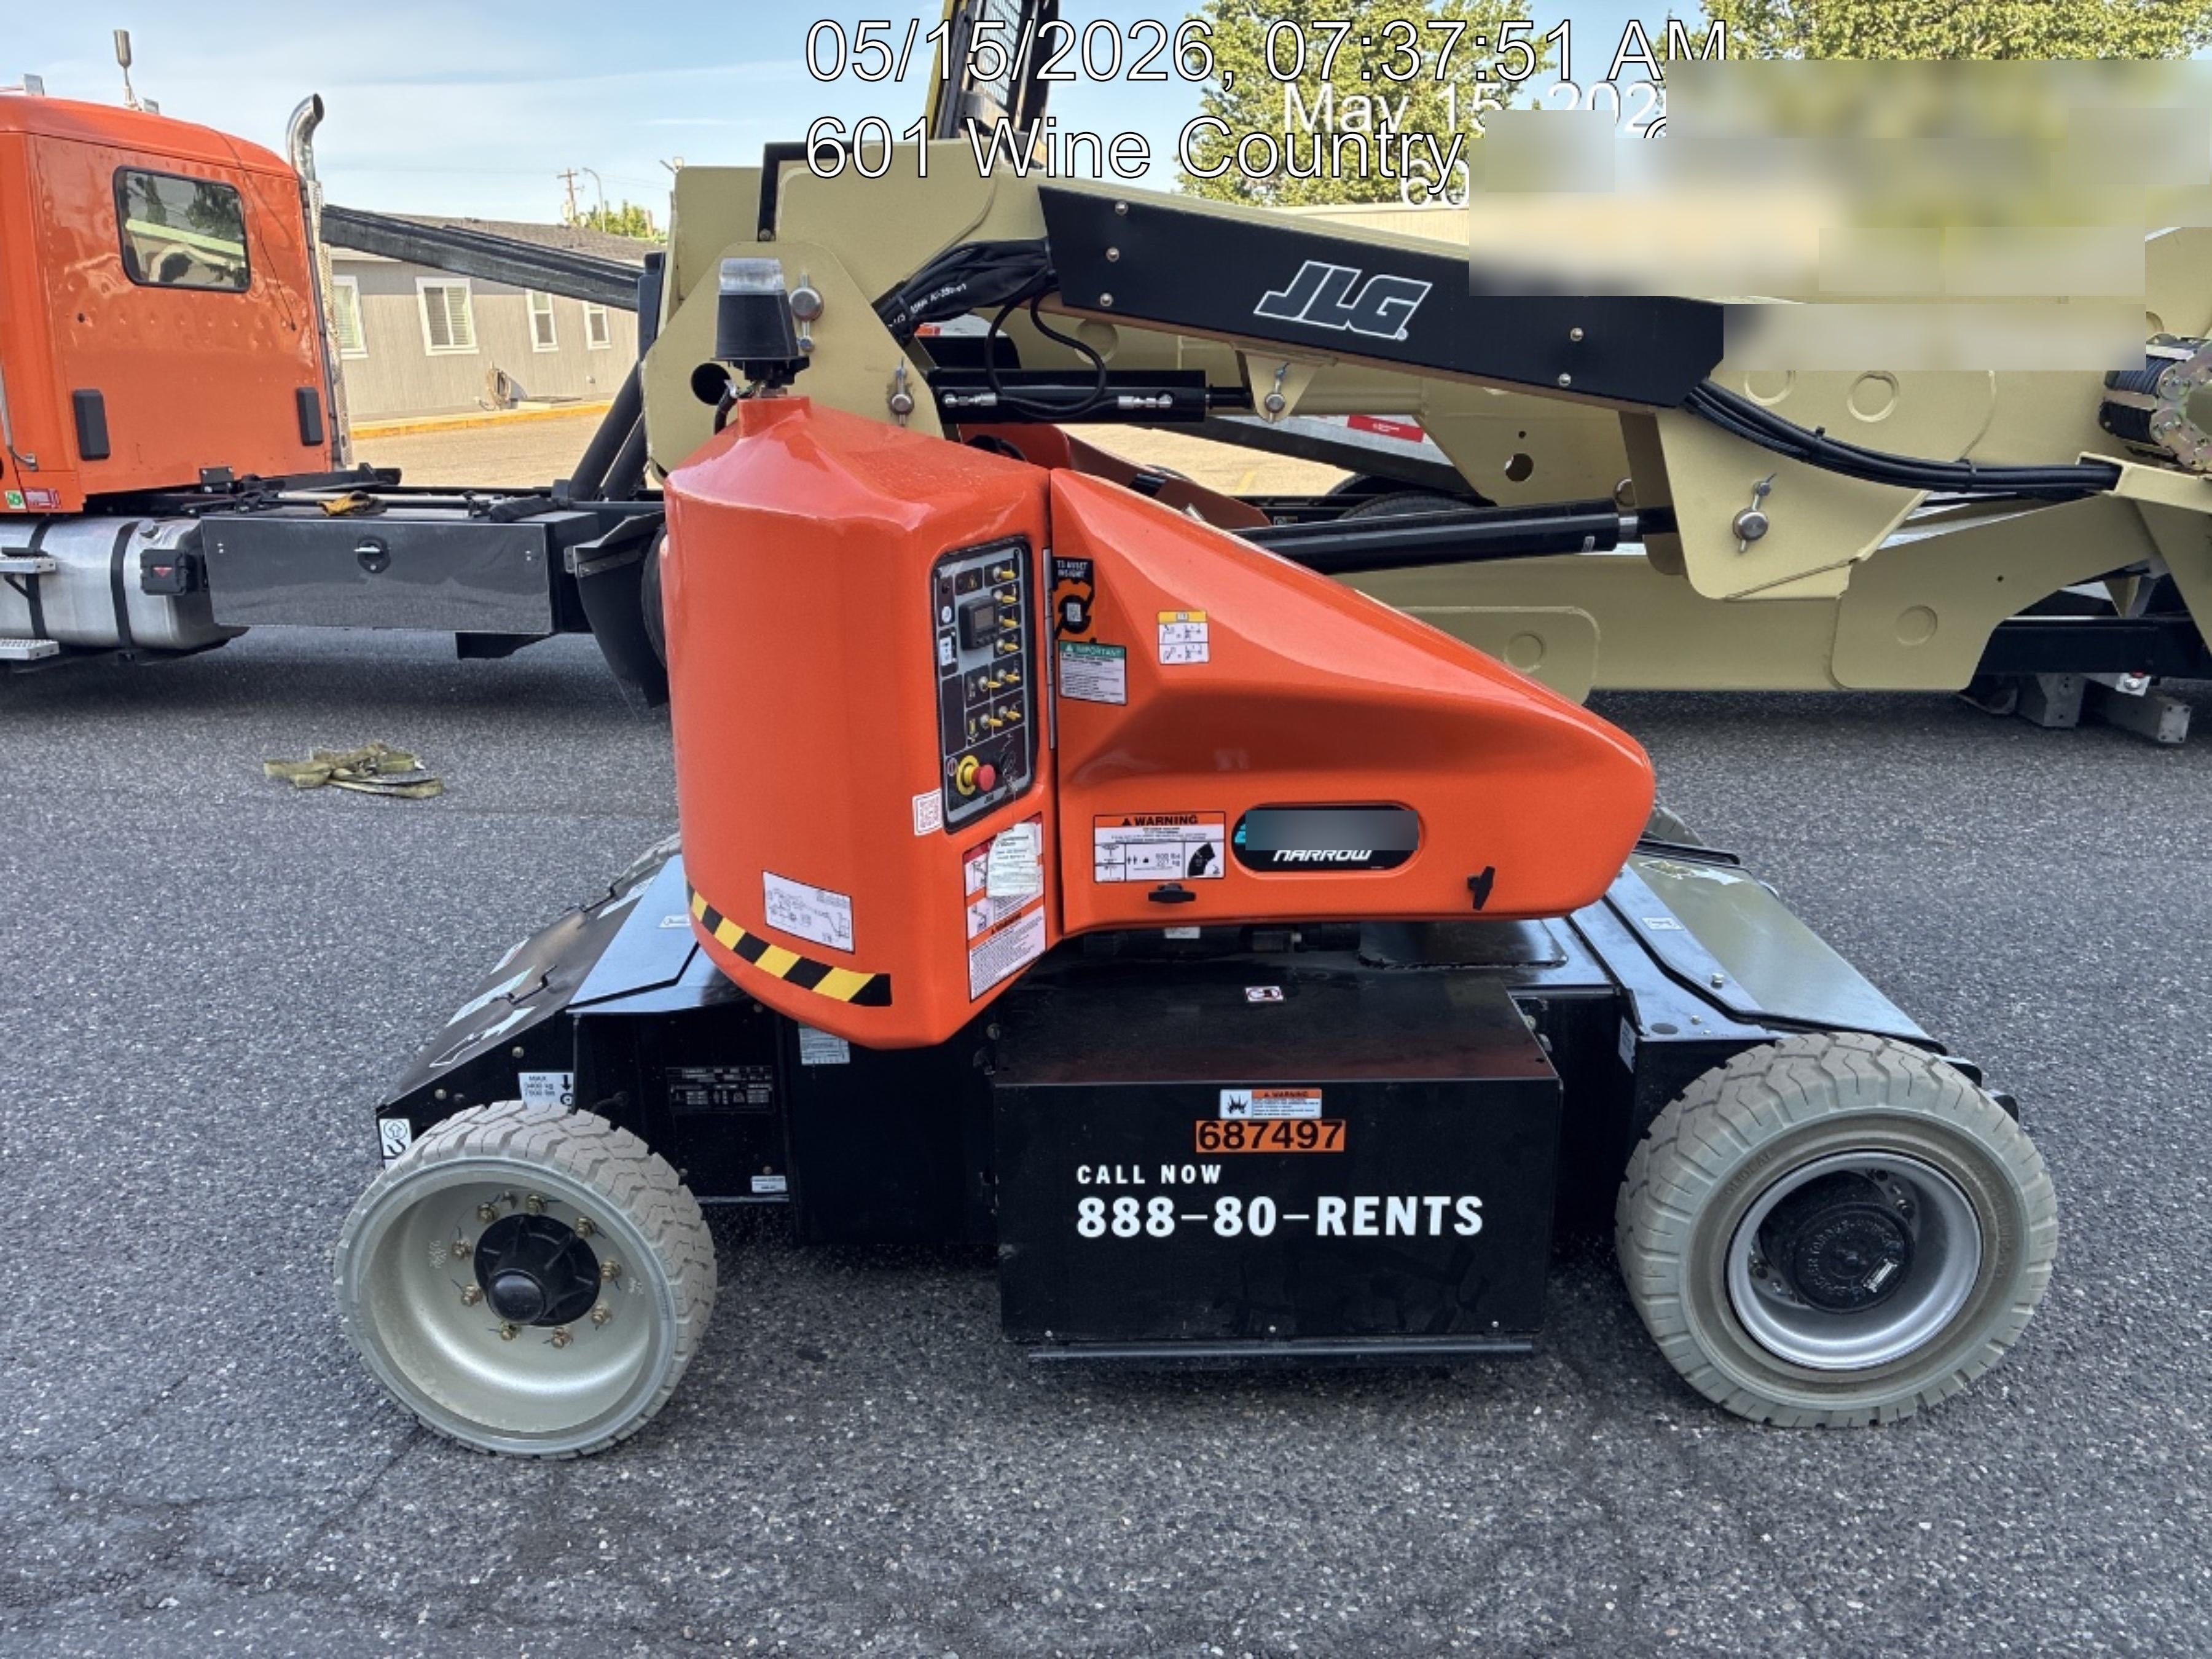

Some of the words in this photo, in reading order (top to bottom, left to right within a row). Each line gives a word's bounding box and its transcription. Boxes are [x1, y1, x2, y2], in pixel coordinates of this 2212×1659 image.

[1253, 260, 1433, 341] JLG
[1077, 646, 1121, 657] IMPORTANT
[1134, 815, 1198, 826] WARNING
[1273, 850, 1372, 861] NARROW
[1198, 1120, 1343, 1150] 687497
[1077, 1164, 1146, 1185] CALL
[1160, 1164, 1222, 1185] NOW
[1076, 1195, 1483, 1238] 888-80-RENTS
